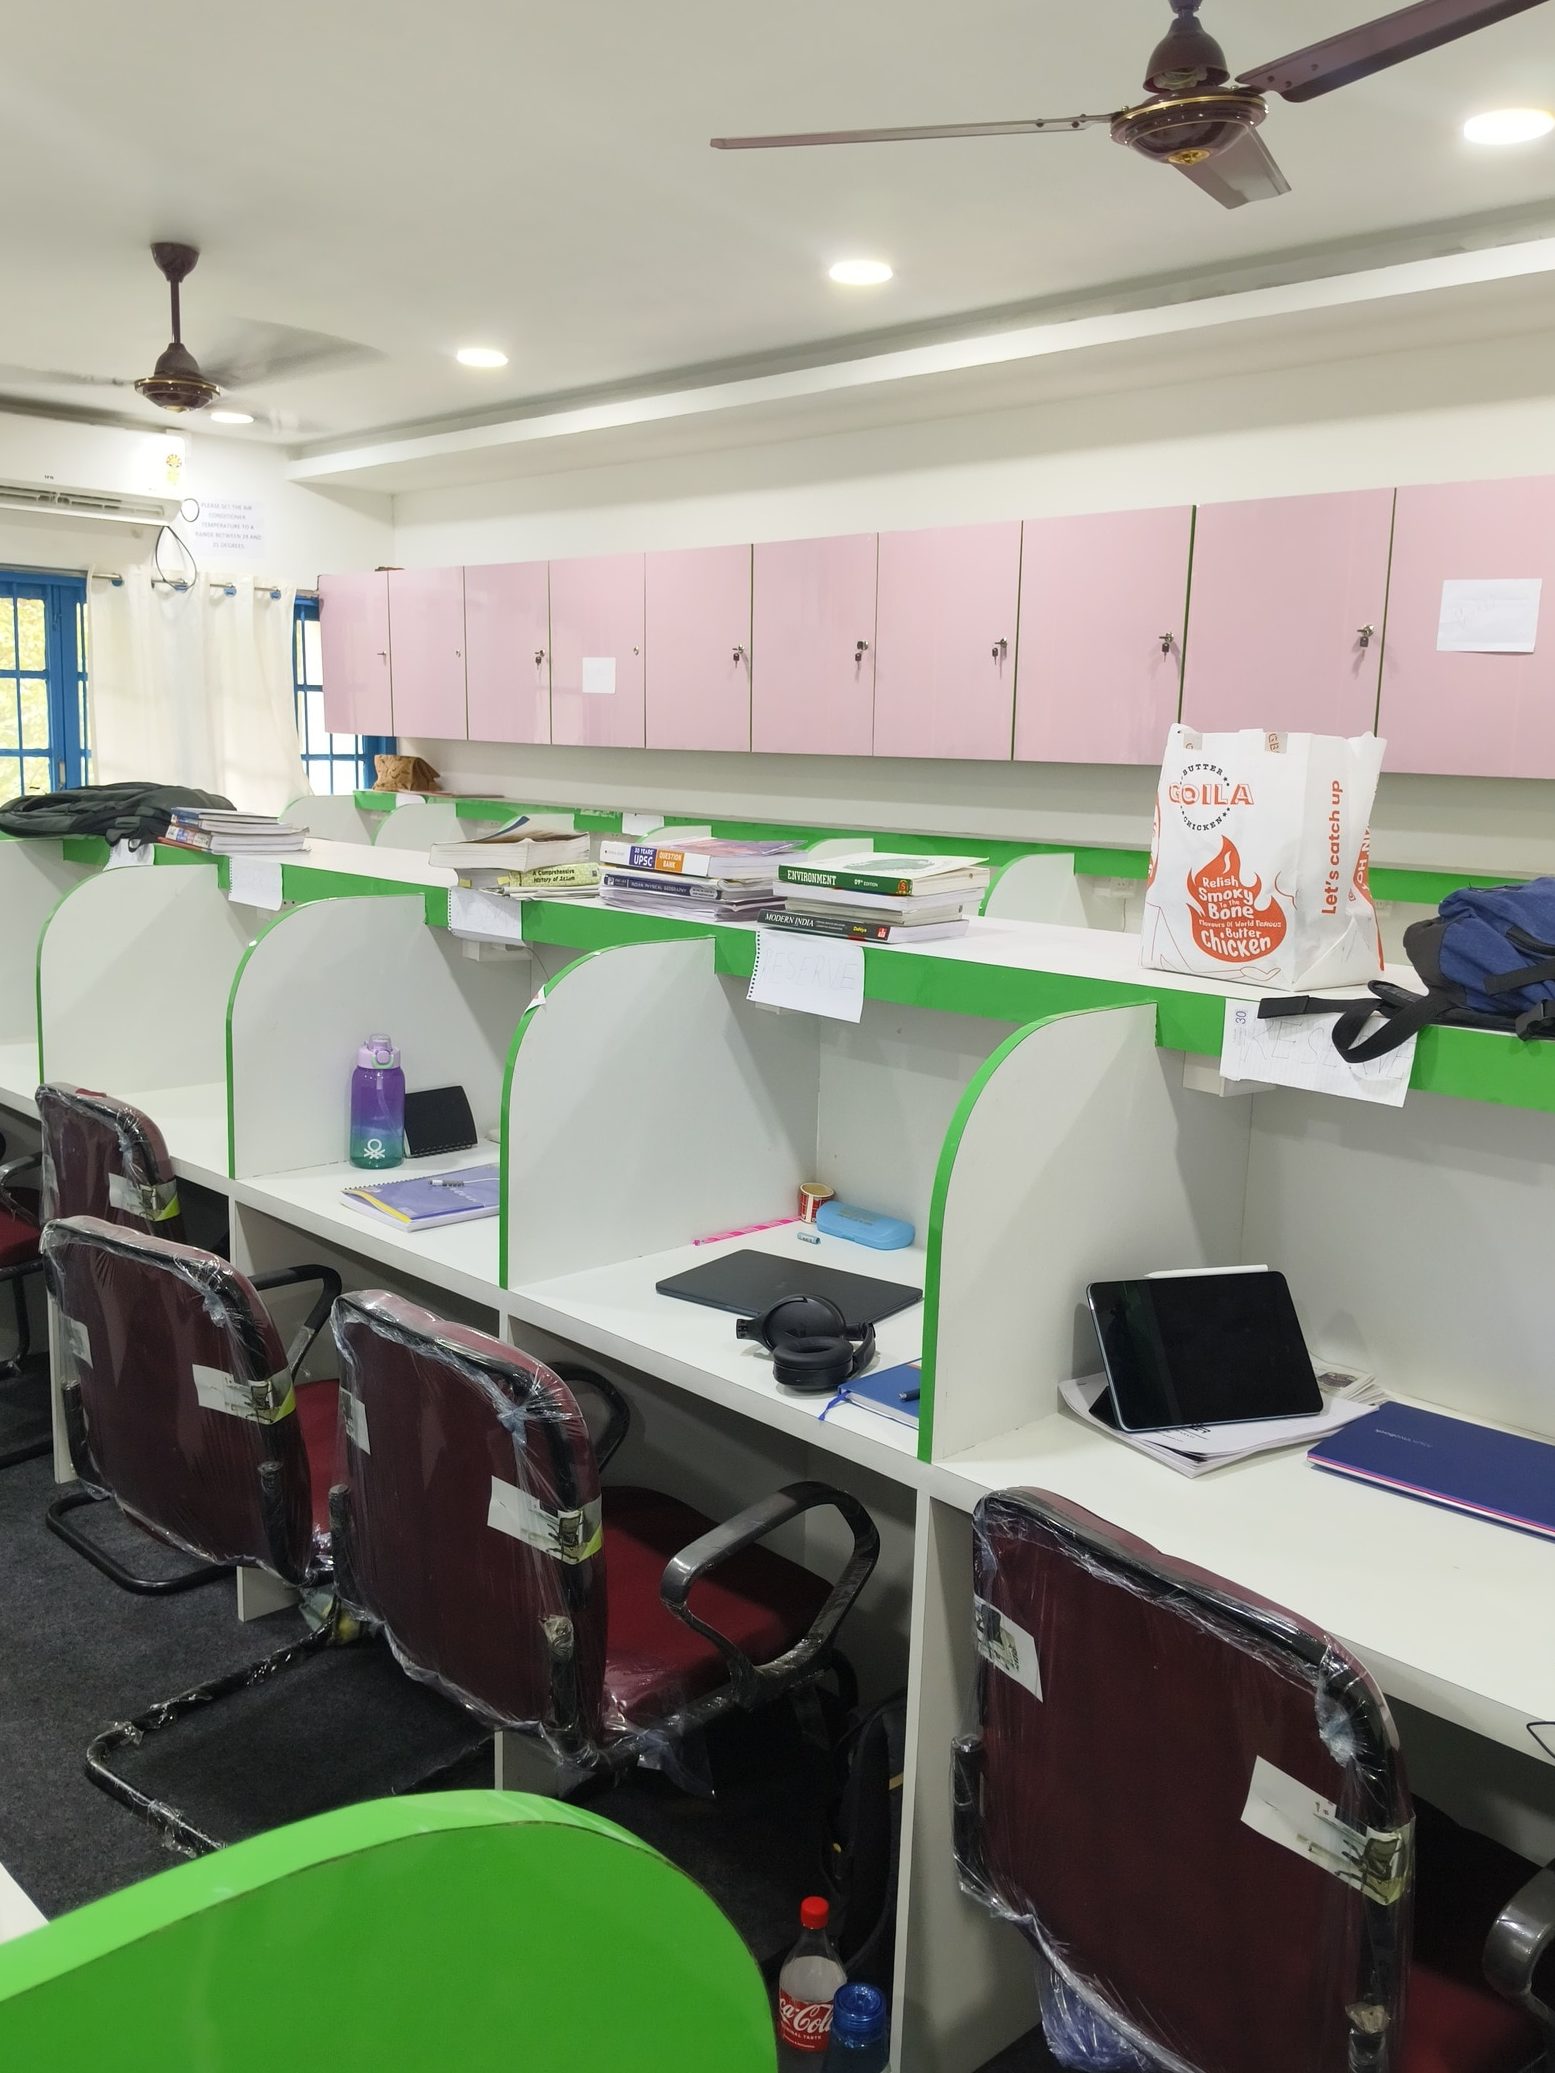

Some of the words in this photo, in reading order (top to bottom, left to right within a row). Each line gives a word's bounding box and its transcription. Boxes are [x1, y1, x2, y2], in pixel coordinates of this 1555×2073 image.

[1182, 763, 1223, 776] BUTTER
[1331, 780, 1343, 805] up
[1183, 816, 1223, 831] CHICKEN
[1328, 809, 1340, 866] catch
[633, 855, 653, 867] UPSC
[787, 869, 836, 886] ENVIRONMENT
[1202, 875, 1239, 888] Relish
[1198, 887, 1254, 905] Smoky
[1321, 870, 1340, 915] Let's
[1208, 902, 1254, 919] Bone
[765, 913, 795, 924] MODERN
[794, 917, 814, 927] INDIA
[1235, 920, 1254, 928] World
[1226, 927, 1262, 938] Butter
[1200, 929, 1271, 957] Chicken
[1235, 1010, 1247, 1024] 30
